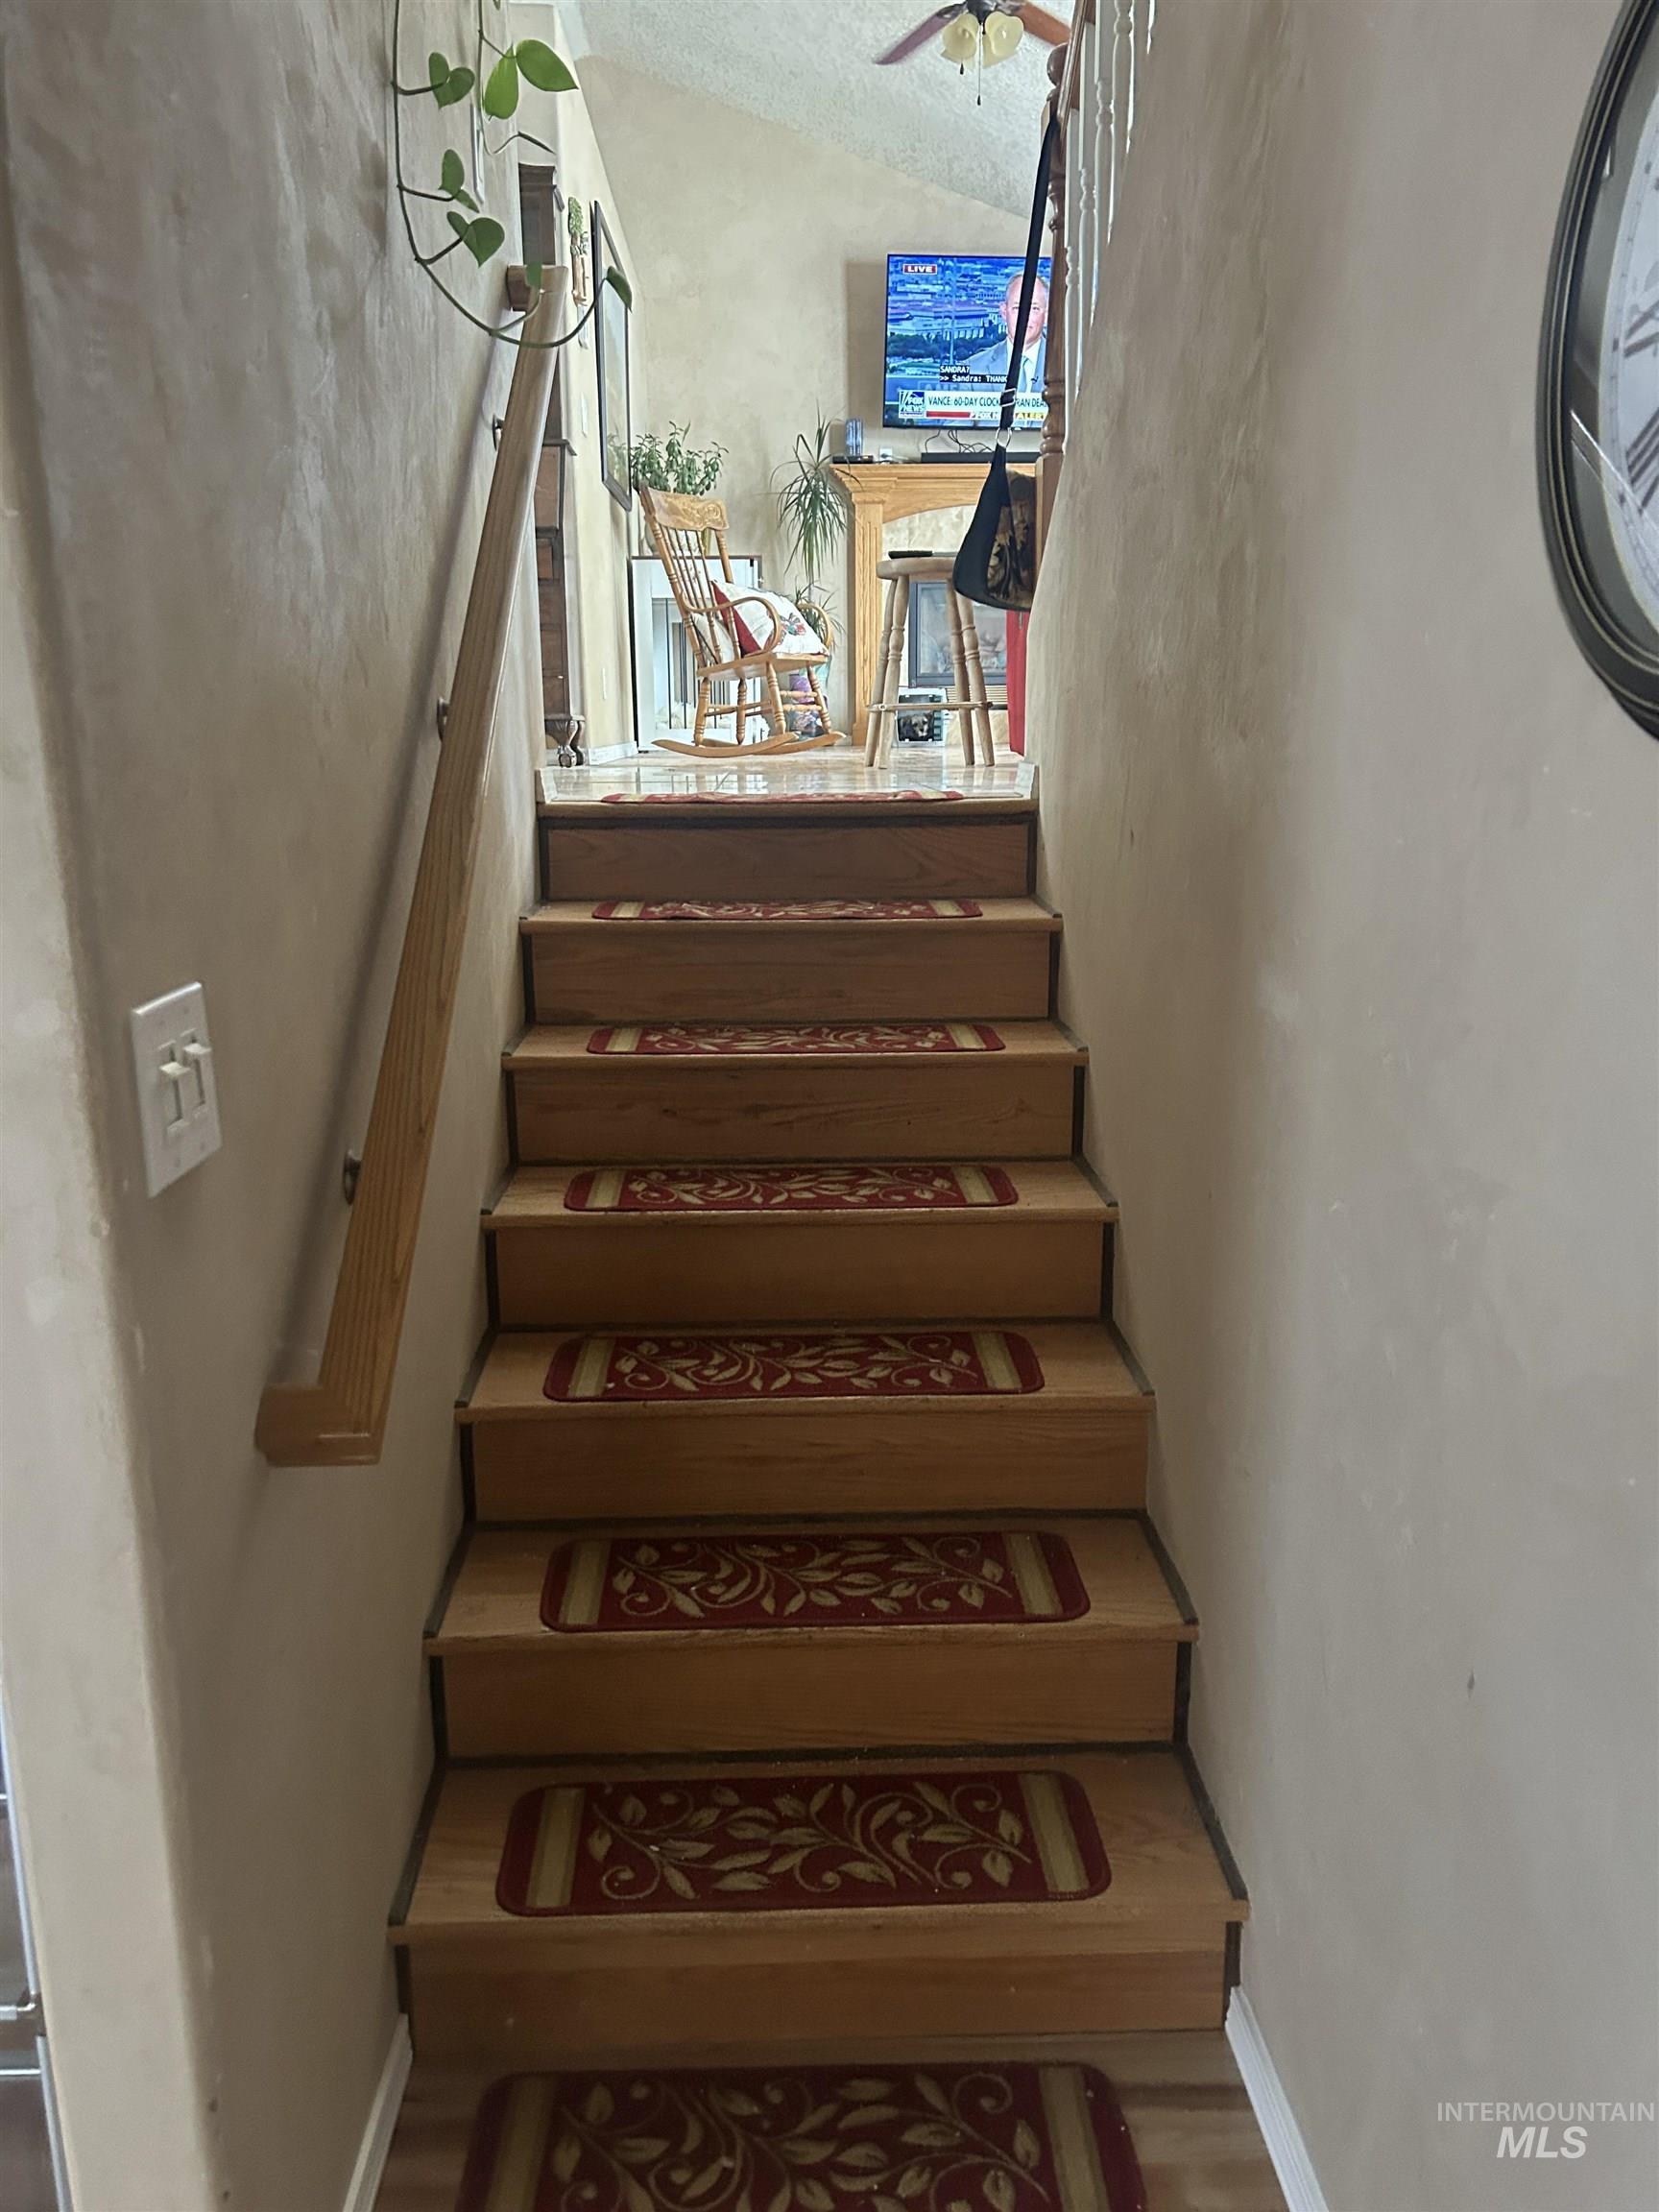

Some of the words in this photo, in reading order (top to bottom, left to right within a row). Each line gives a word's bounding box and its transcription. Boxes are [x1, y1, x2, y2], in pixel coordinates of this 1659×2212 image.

[986, 374, 1008, 383] THANK
[928, 397, 952, 405] VANCE:
[953, 397, 978, 406] 60-DAY
